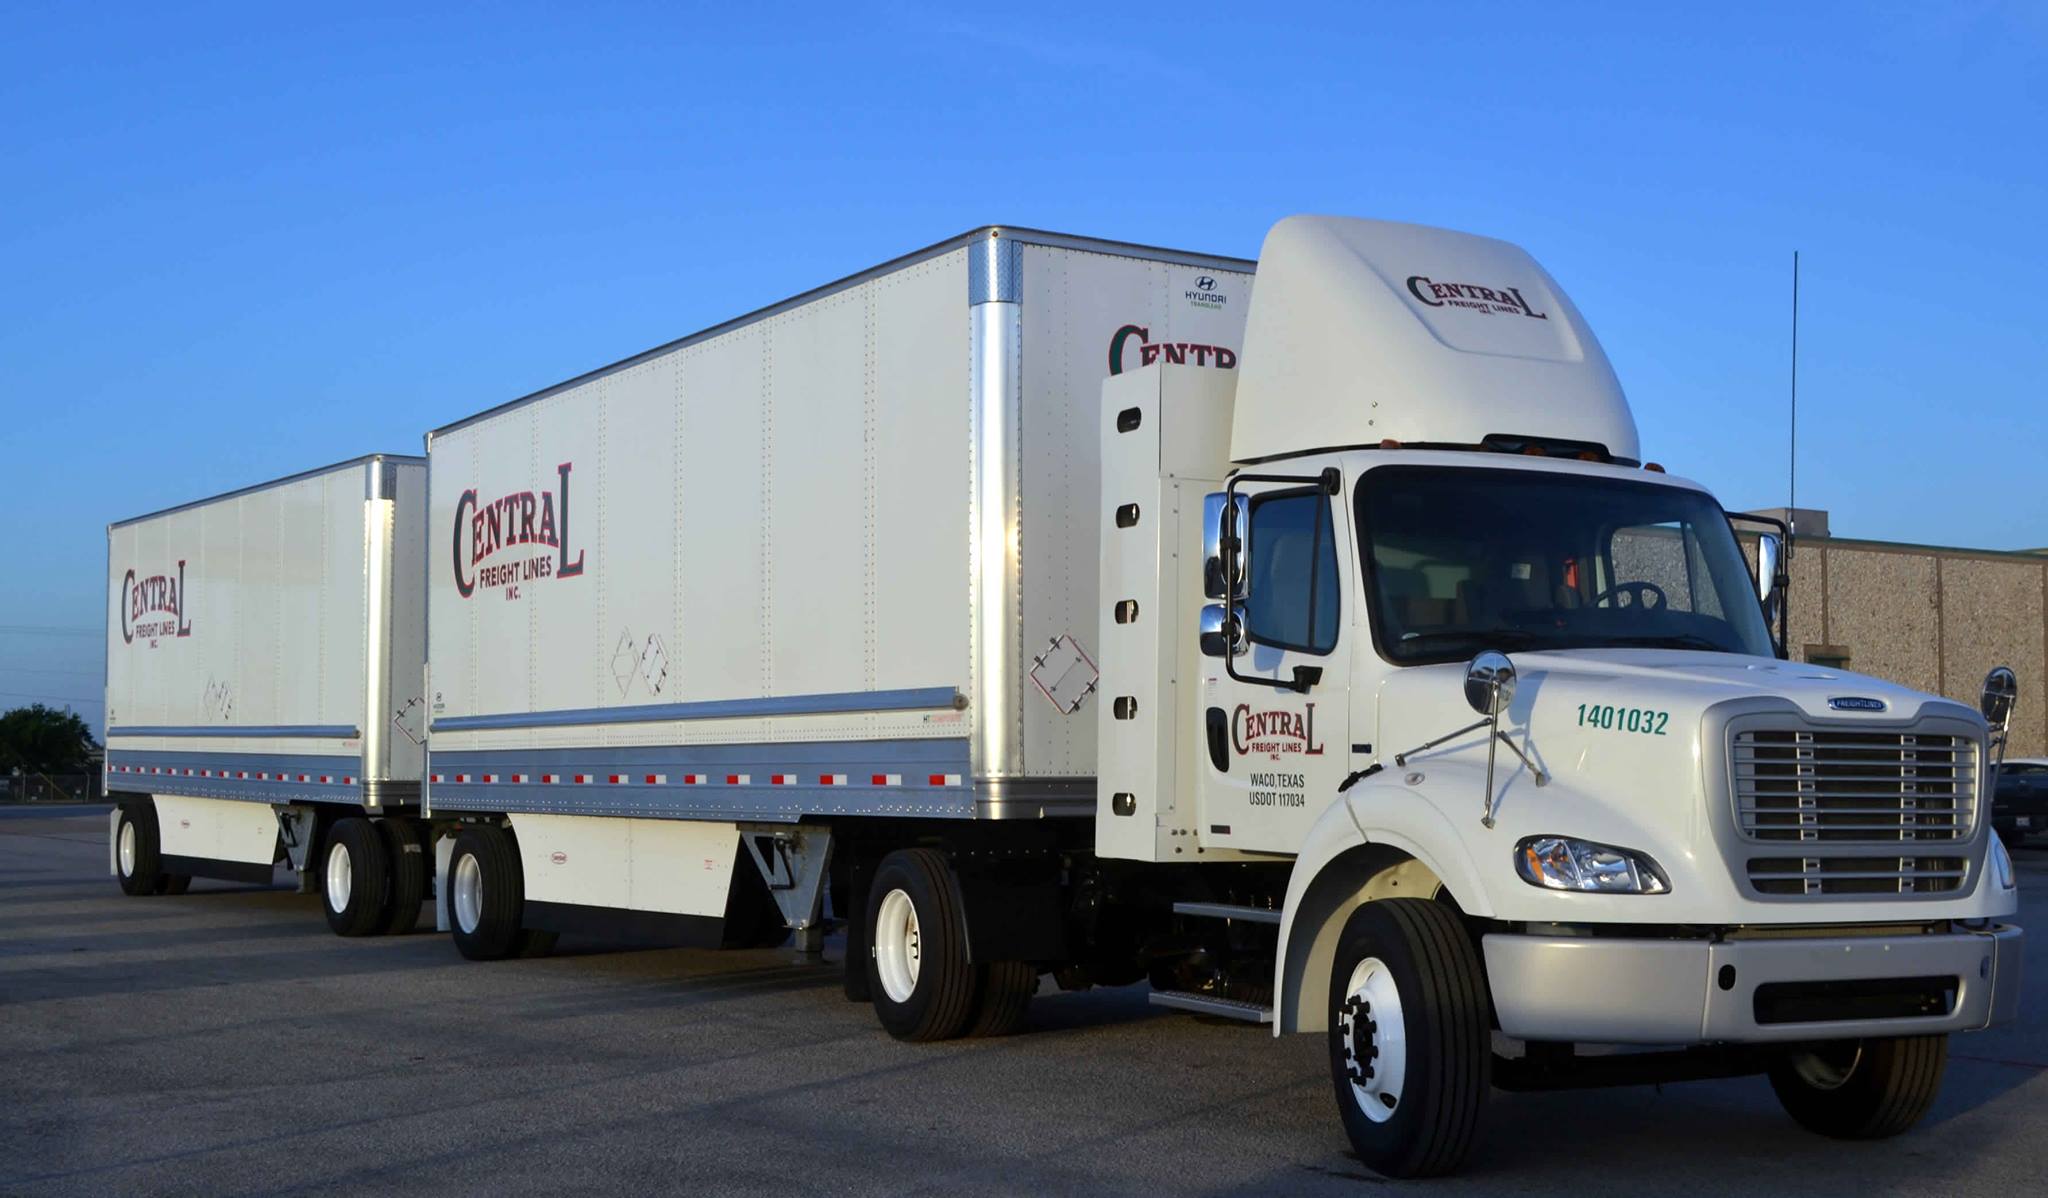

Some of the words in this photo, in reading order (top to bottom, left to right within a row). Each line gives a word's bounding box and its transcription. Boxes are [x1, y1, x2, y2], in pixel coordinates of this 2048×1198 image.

[1185, 291, 1227, 304] HYUNDAI
[1406, 276, 1548, 320] CENTRAL
[1448, 300, 1489, 311] FREIGHT
[1492, 304, 1520, 314] LINES
[453, 462, 584, 598] CENTRAL
[480, 561, 520, 589] FREIGHT
[523, 556, 552, 581] LINES
[122, 560, 191, 645] CENTRAL
[136, 622, 158, 639] FREIGHT
[159, 620, 175, 636] LINES
[1232, 703, 1324, 755] CENTRAL
[1578, 703, 1669, 736] 1401032
[1251, 742, 1280, 753] FREIGHT
[1282, 743, 1302, 753] LINES
[1249, 792, 1276, 806] USDOT
[1278, 793, 1305, 807] 117034
